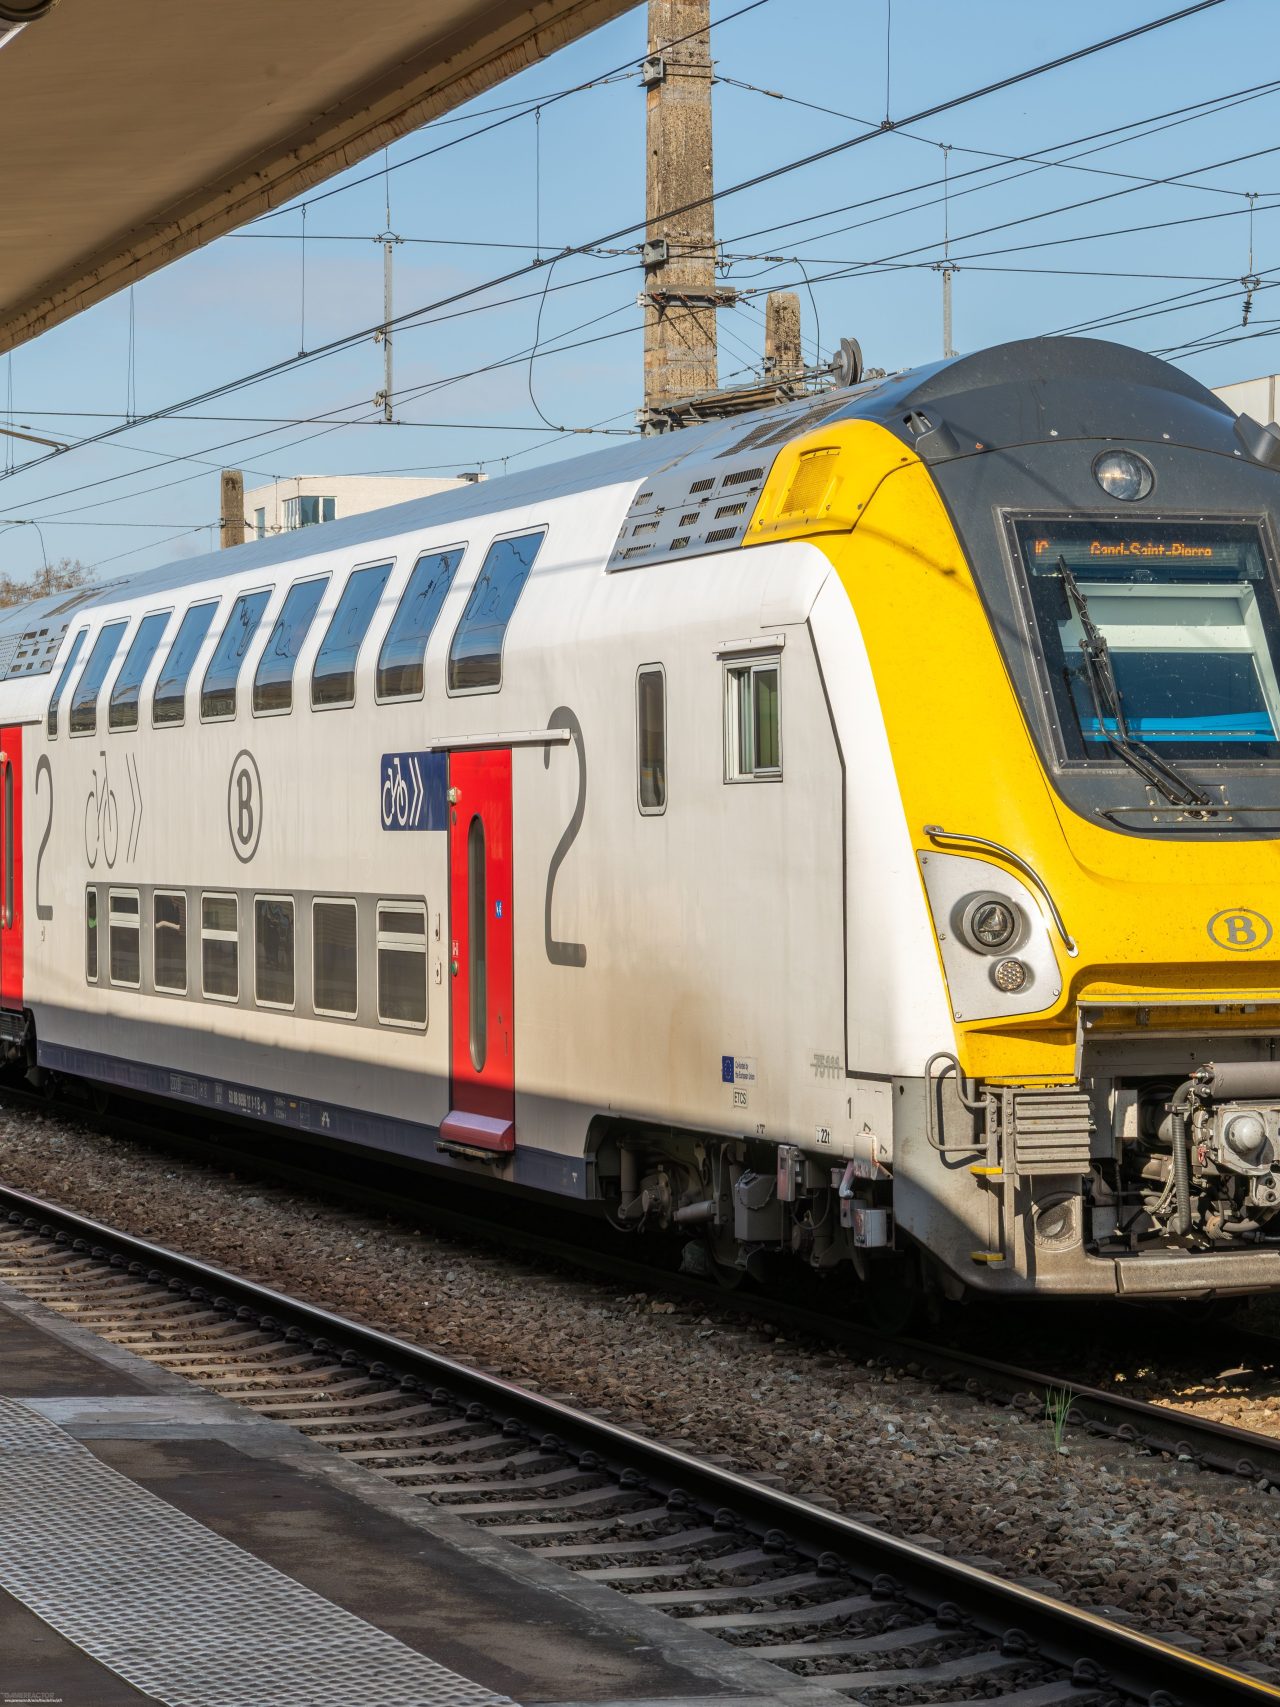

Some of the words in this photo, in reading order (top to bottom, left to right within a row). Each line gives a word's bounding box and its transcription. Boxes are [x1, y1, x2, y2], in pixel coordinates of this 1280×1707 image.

[35, 753, 54, 921] 2
[543, 705, 587, 968] 2
[734, 1091, 747, 1105] ETCS
[847, 1097, 852, 1119] 1
